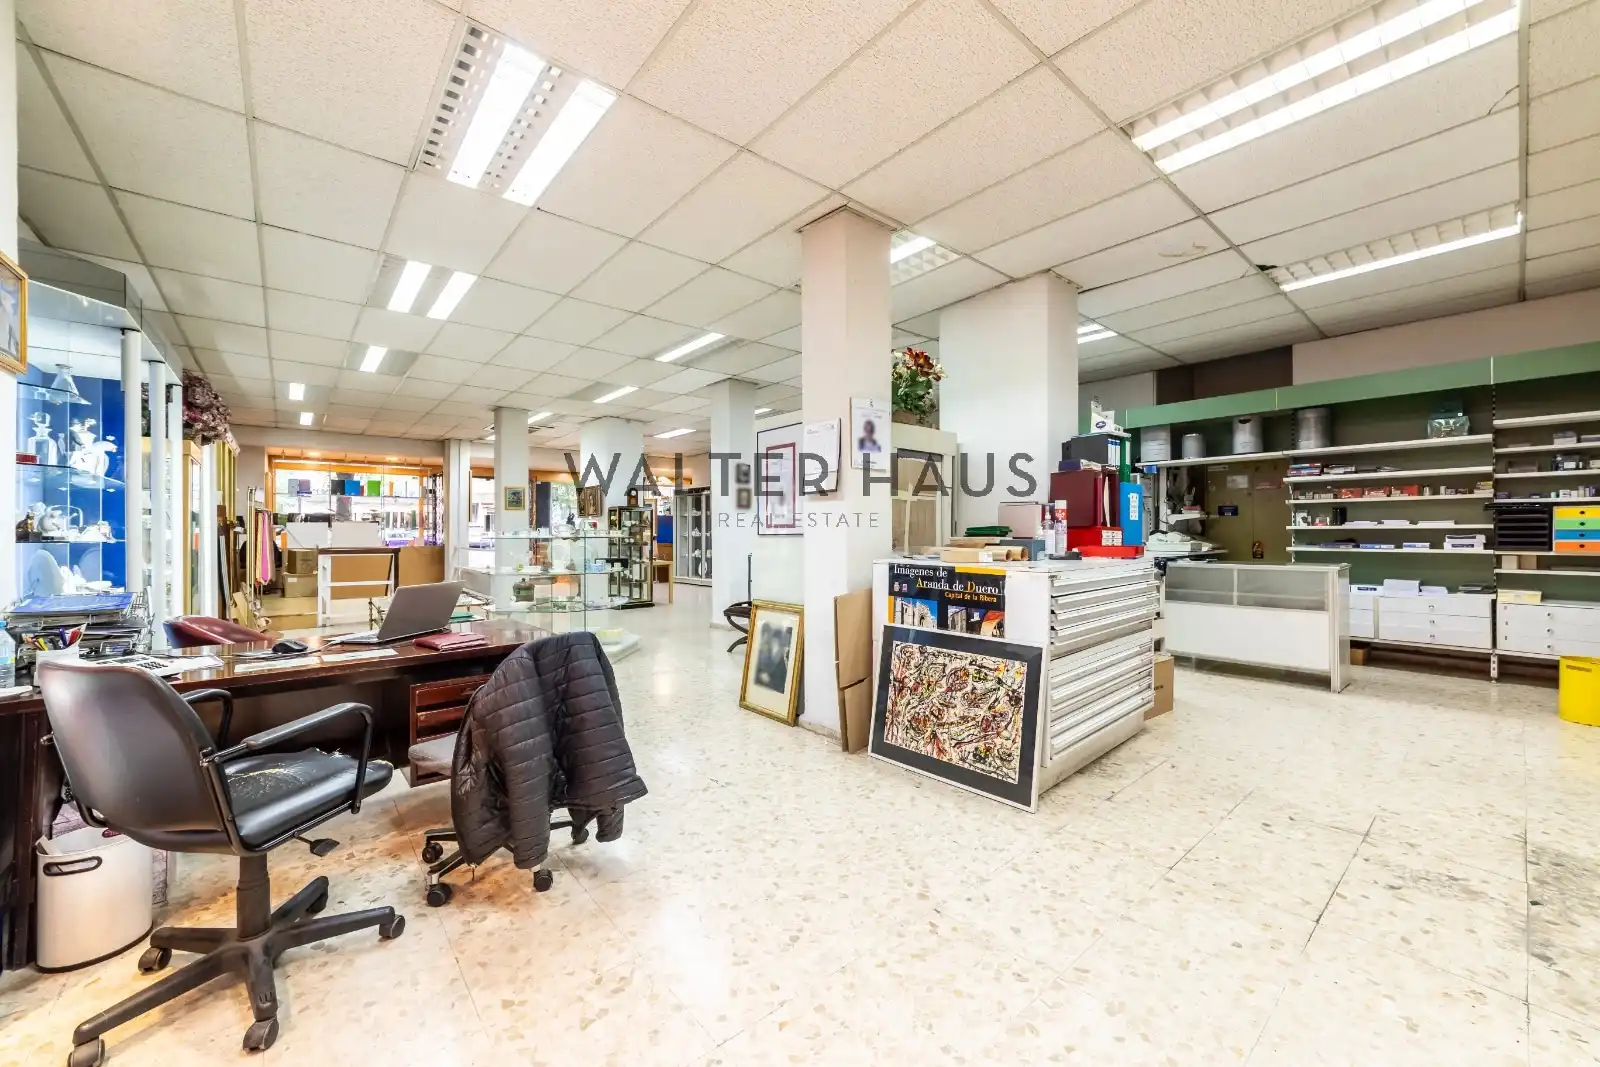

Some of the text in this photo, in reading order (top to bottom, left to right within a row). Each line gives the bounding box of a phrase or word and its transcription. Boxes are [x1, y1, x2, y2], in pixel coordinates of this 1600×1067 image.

[894, 564, 948, 578] Imágenes de
[916, 577, 999, 594] Aranda de Duero
[944, 591, 963, 600] Capital
